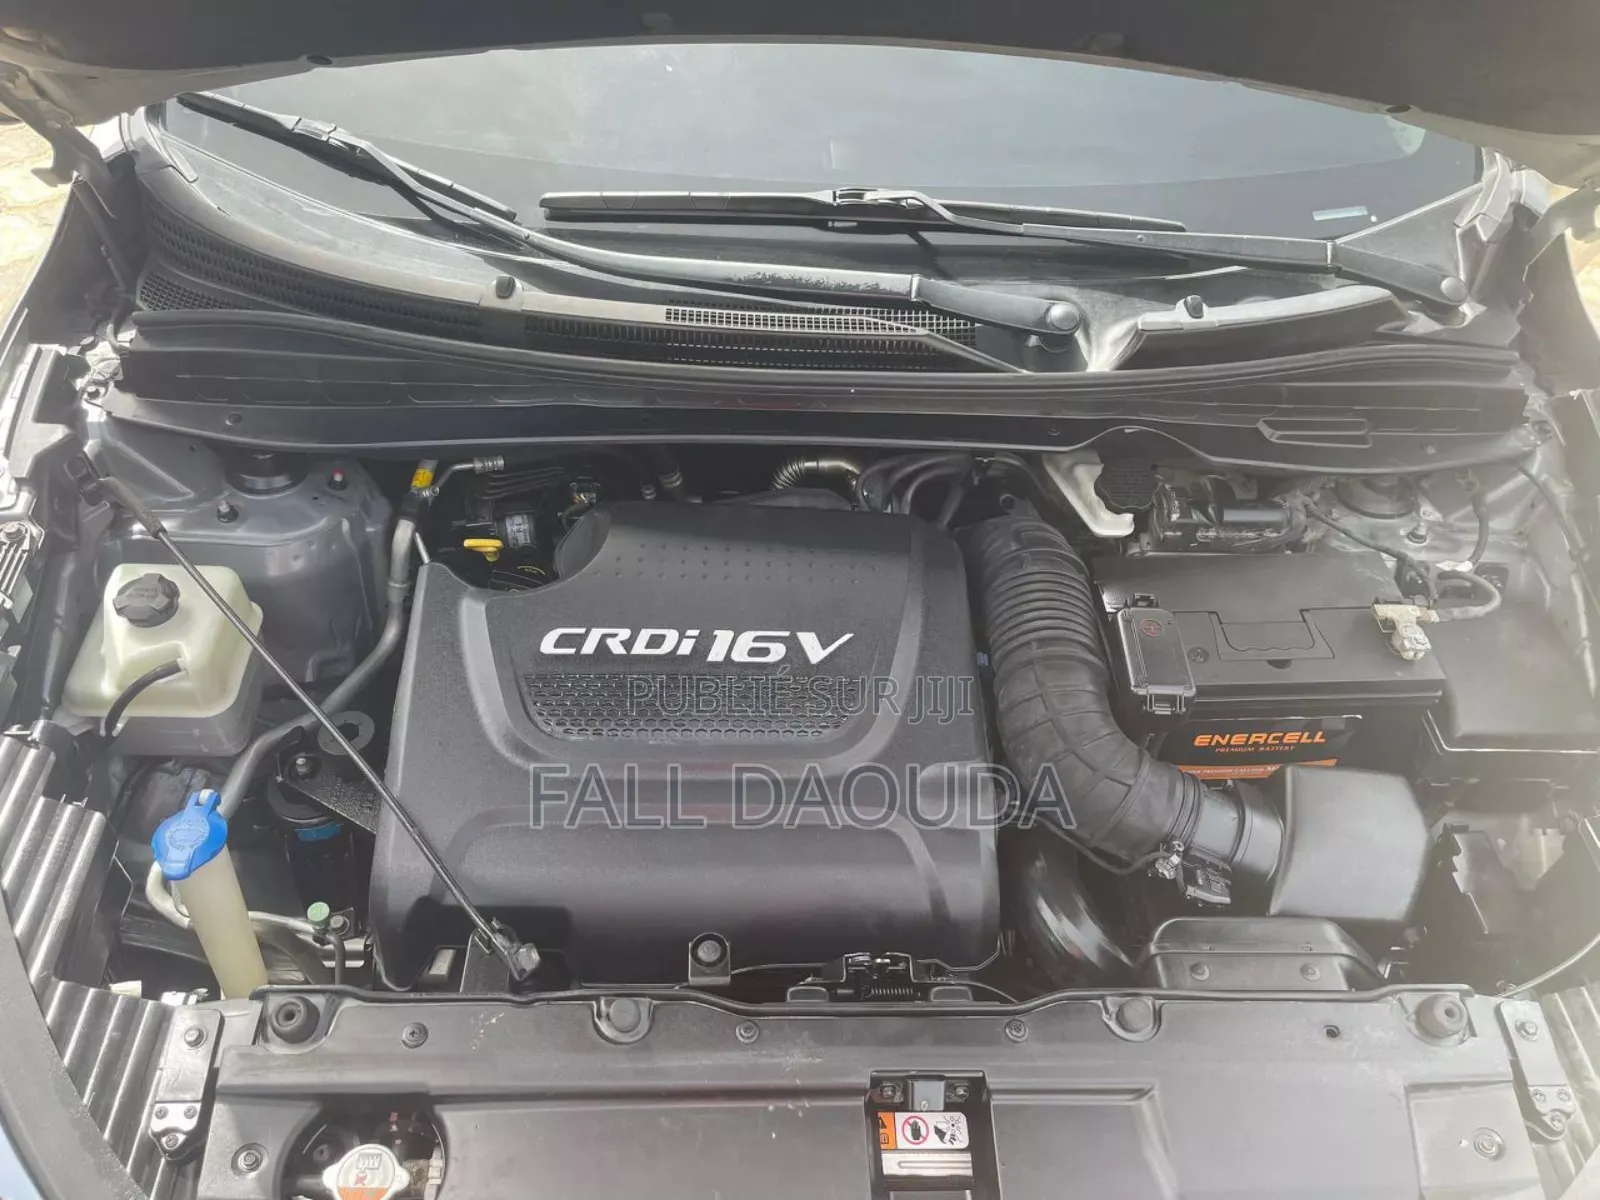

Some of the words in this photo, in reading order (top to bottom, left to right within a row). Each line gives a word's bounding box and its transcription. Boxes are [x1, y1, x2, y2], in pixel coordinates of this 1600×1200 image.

[539, 627, 700, 656] CRDi
[706, 629, 855, 665] 16V
[1194, 731, 1326, 746] ENERCELL
[1258, 745, 1296, 753] BATTERY
